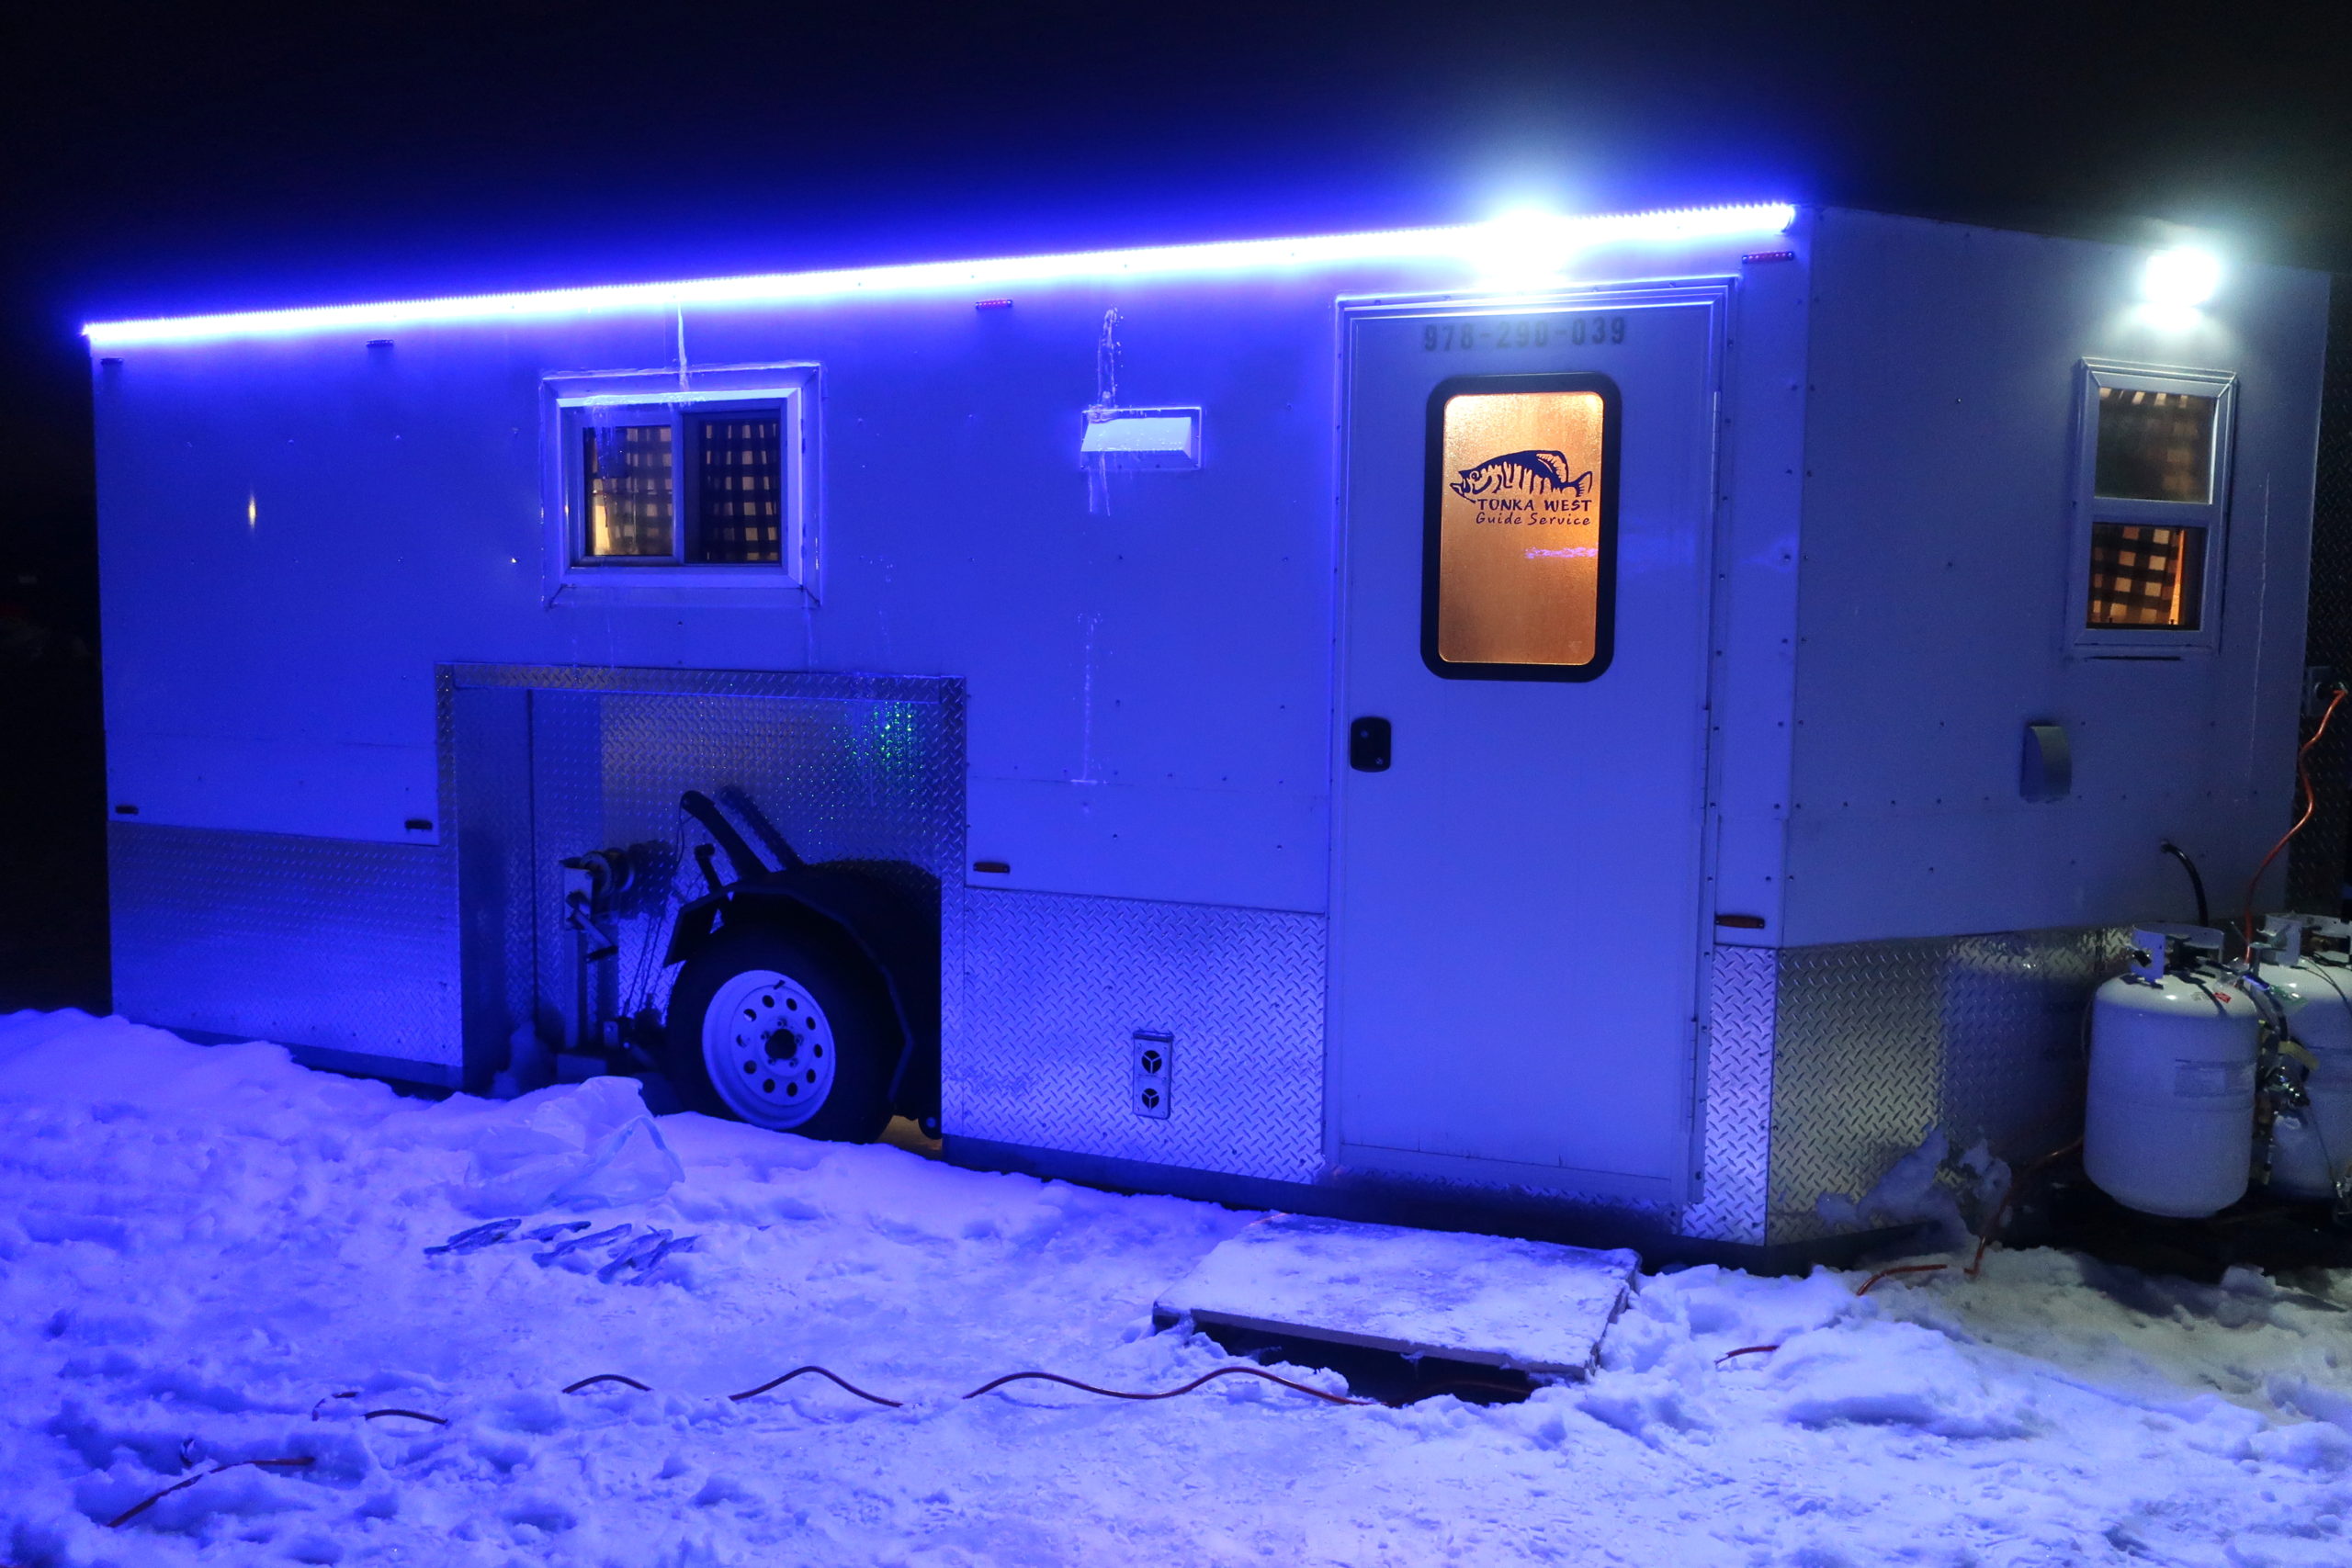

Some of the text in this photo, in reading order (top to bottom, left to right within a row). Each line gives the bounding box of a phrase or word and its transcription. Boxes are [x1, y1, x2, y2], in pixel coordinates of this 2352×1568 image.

[1477, 499, 1592, 512] TONKA WEST
[1476, 512, 1591, 525] Guide Service
